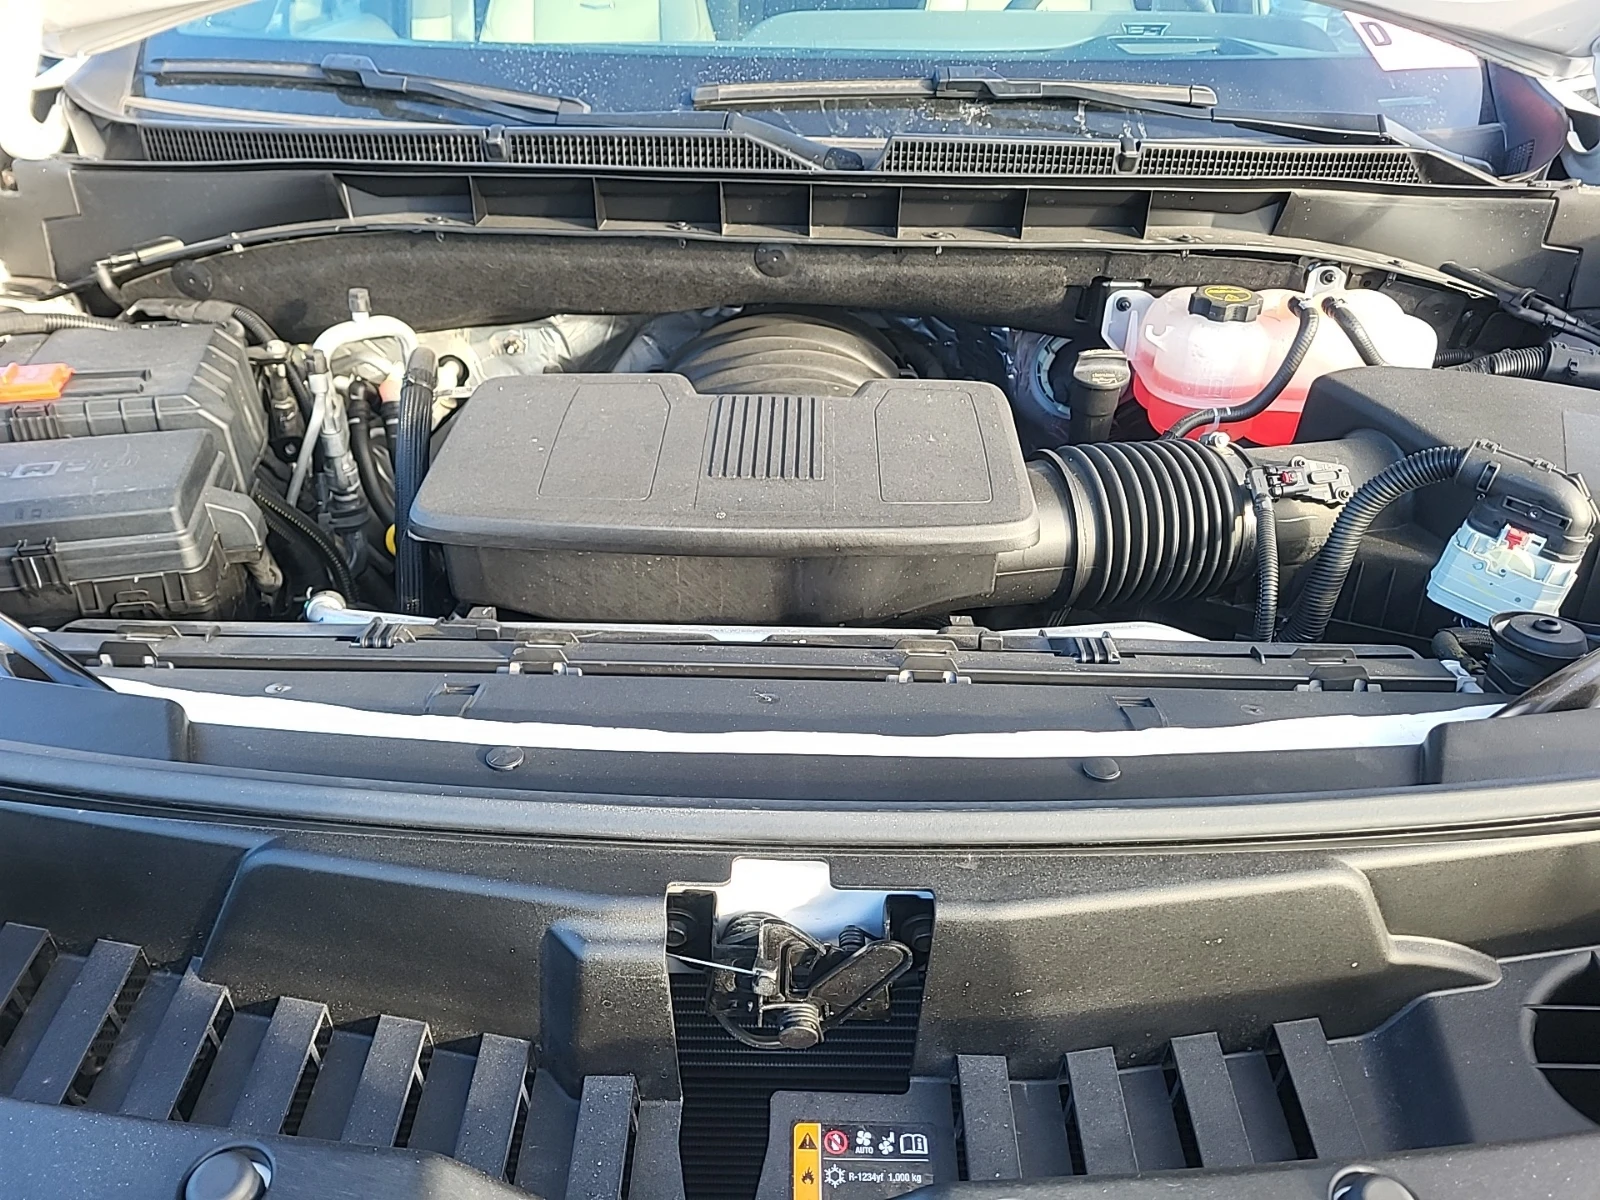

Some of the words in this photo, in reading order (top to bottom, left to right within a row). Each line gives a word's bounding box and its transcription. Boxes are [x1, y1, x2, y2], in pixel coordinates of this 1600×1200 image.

[855, 1146, 874, 1154] AUTO
[848, 1172, 884, 1184] R-1234yf
[888, 1172, 910, 1183] 1.000
[911, 1173, 922, 1184] kg
